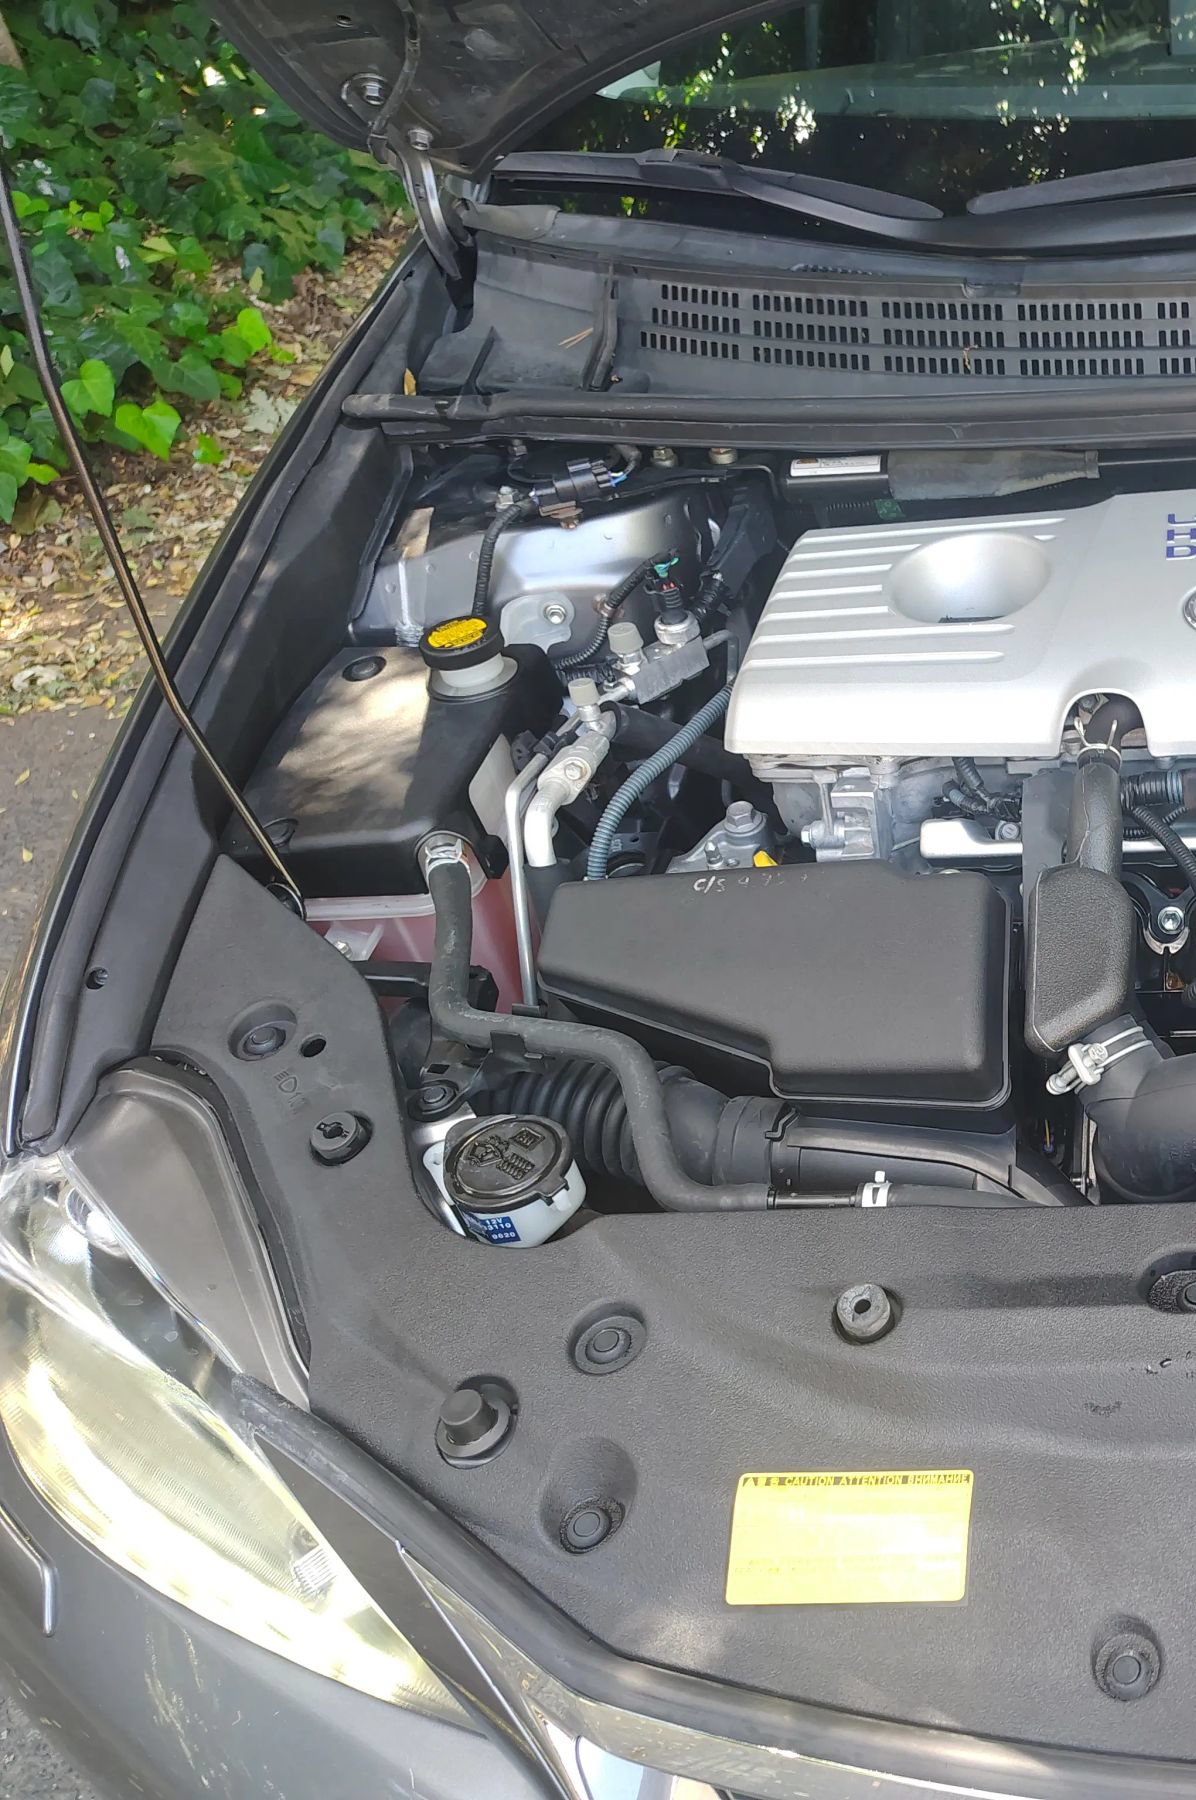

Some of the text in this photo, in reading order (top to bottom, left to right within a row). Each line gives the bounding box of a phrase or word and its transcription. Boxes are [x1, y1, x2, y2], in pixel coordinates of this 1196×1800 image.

[486, 1217, 503, 1225] 12V
[785, 1476, 834, 1487] CAUTION
[840, 1475, 902, 1485] ATTENTION
